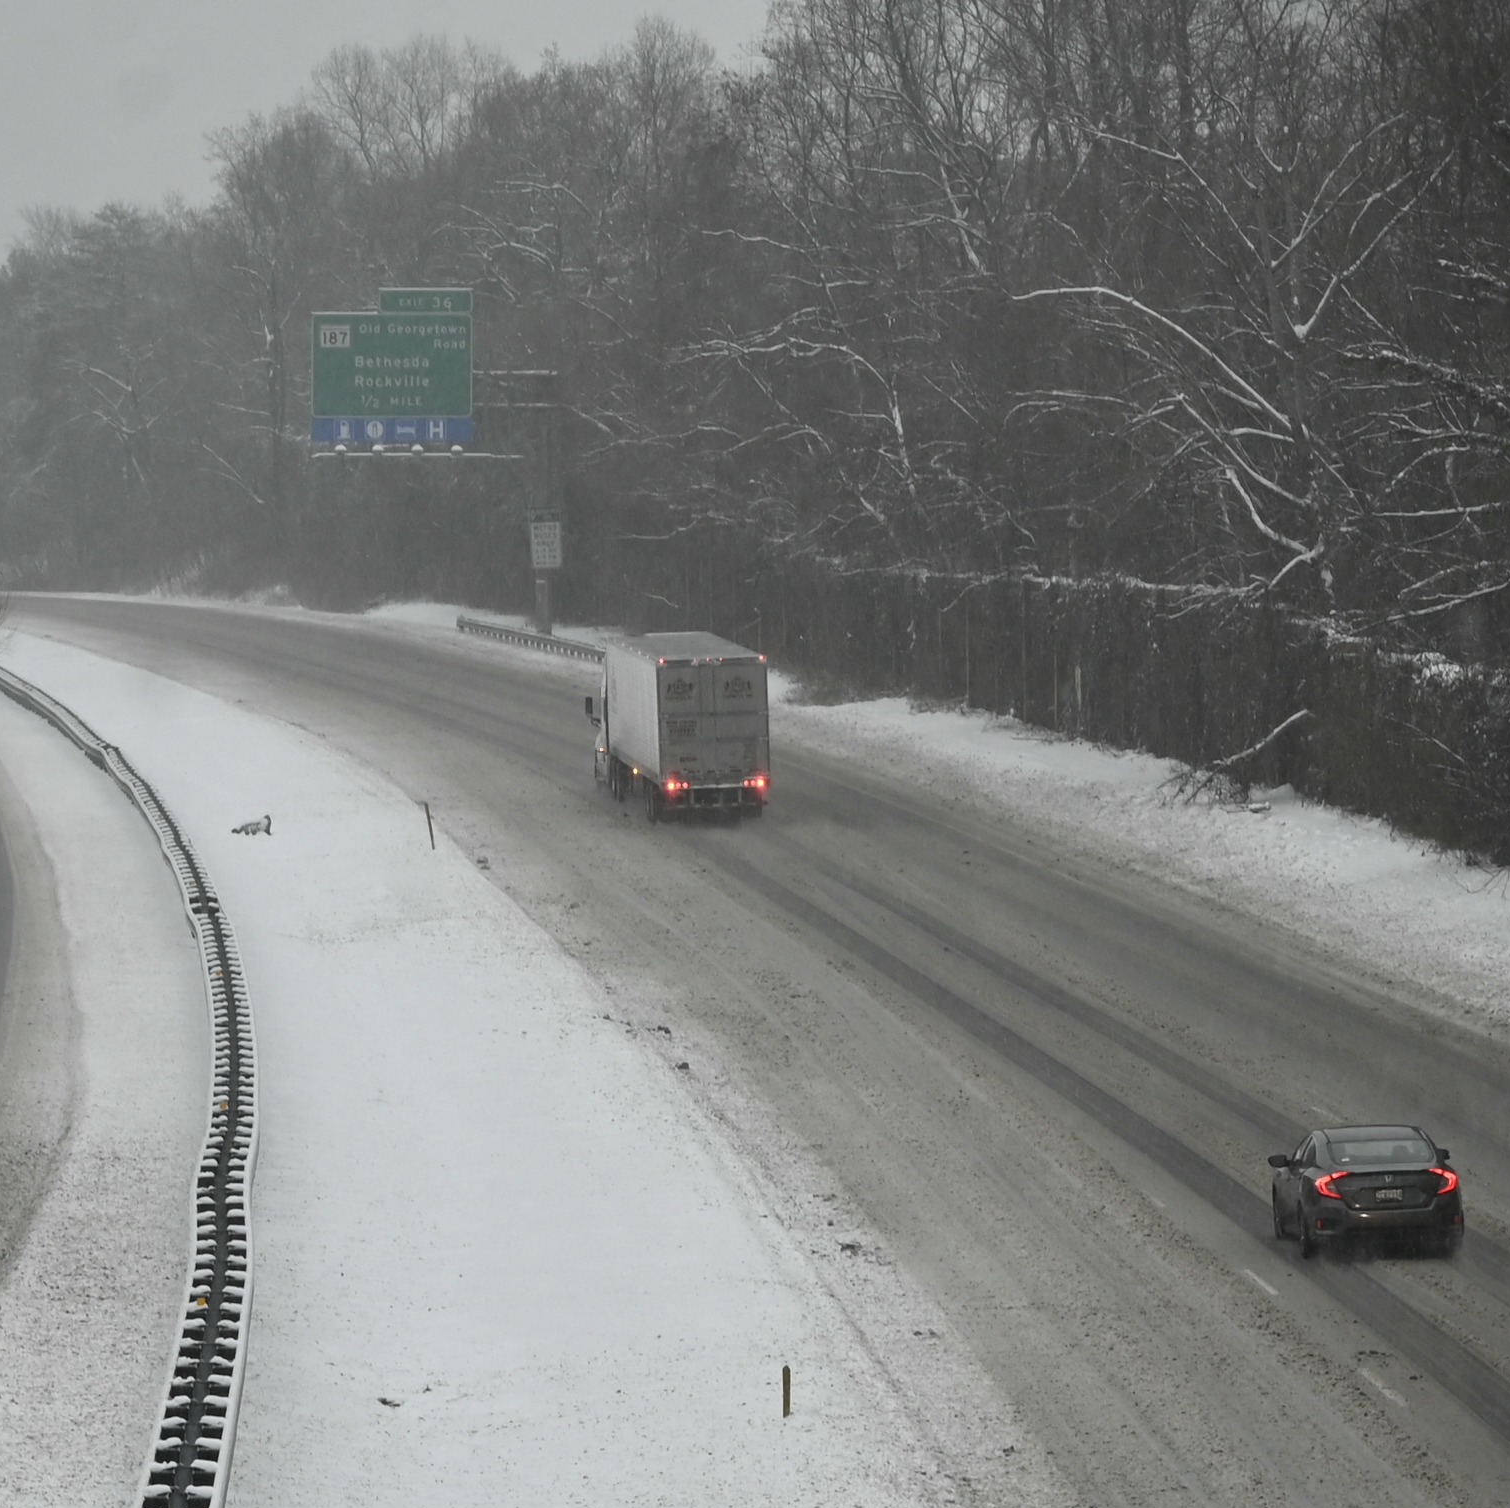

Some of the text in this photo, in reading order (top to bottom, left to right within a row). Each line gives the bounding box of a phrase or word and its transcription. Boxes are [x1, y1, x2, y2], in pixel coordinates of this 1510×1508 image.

[399, 297, 452, 308] EXIT 36
[359, 324, 466, 336] Old Georgetown
[322, 331, 348, 345] 187
[434, 339, 466, 349] Road
[354, 356, 430, 368] Bethesda
[354, 375, 430, 387] Rockville
[390, 396, 422, 406] MILE
